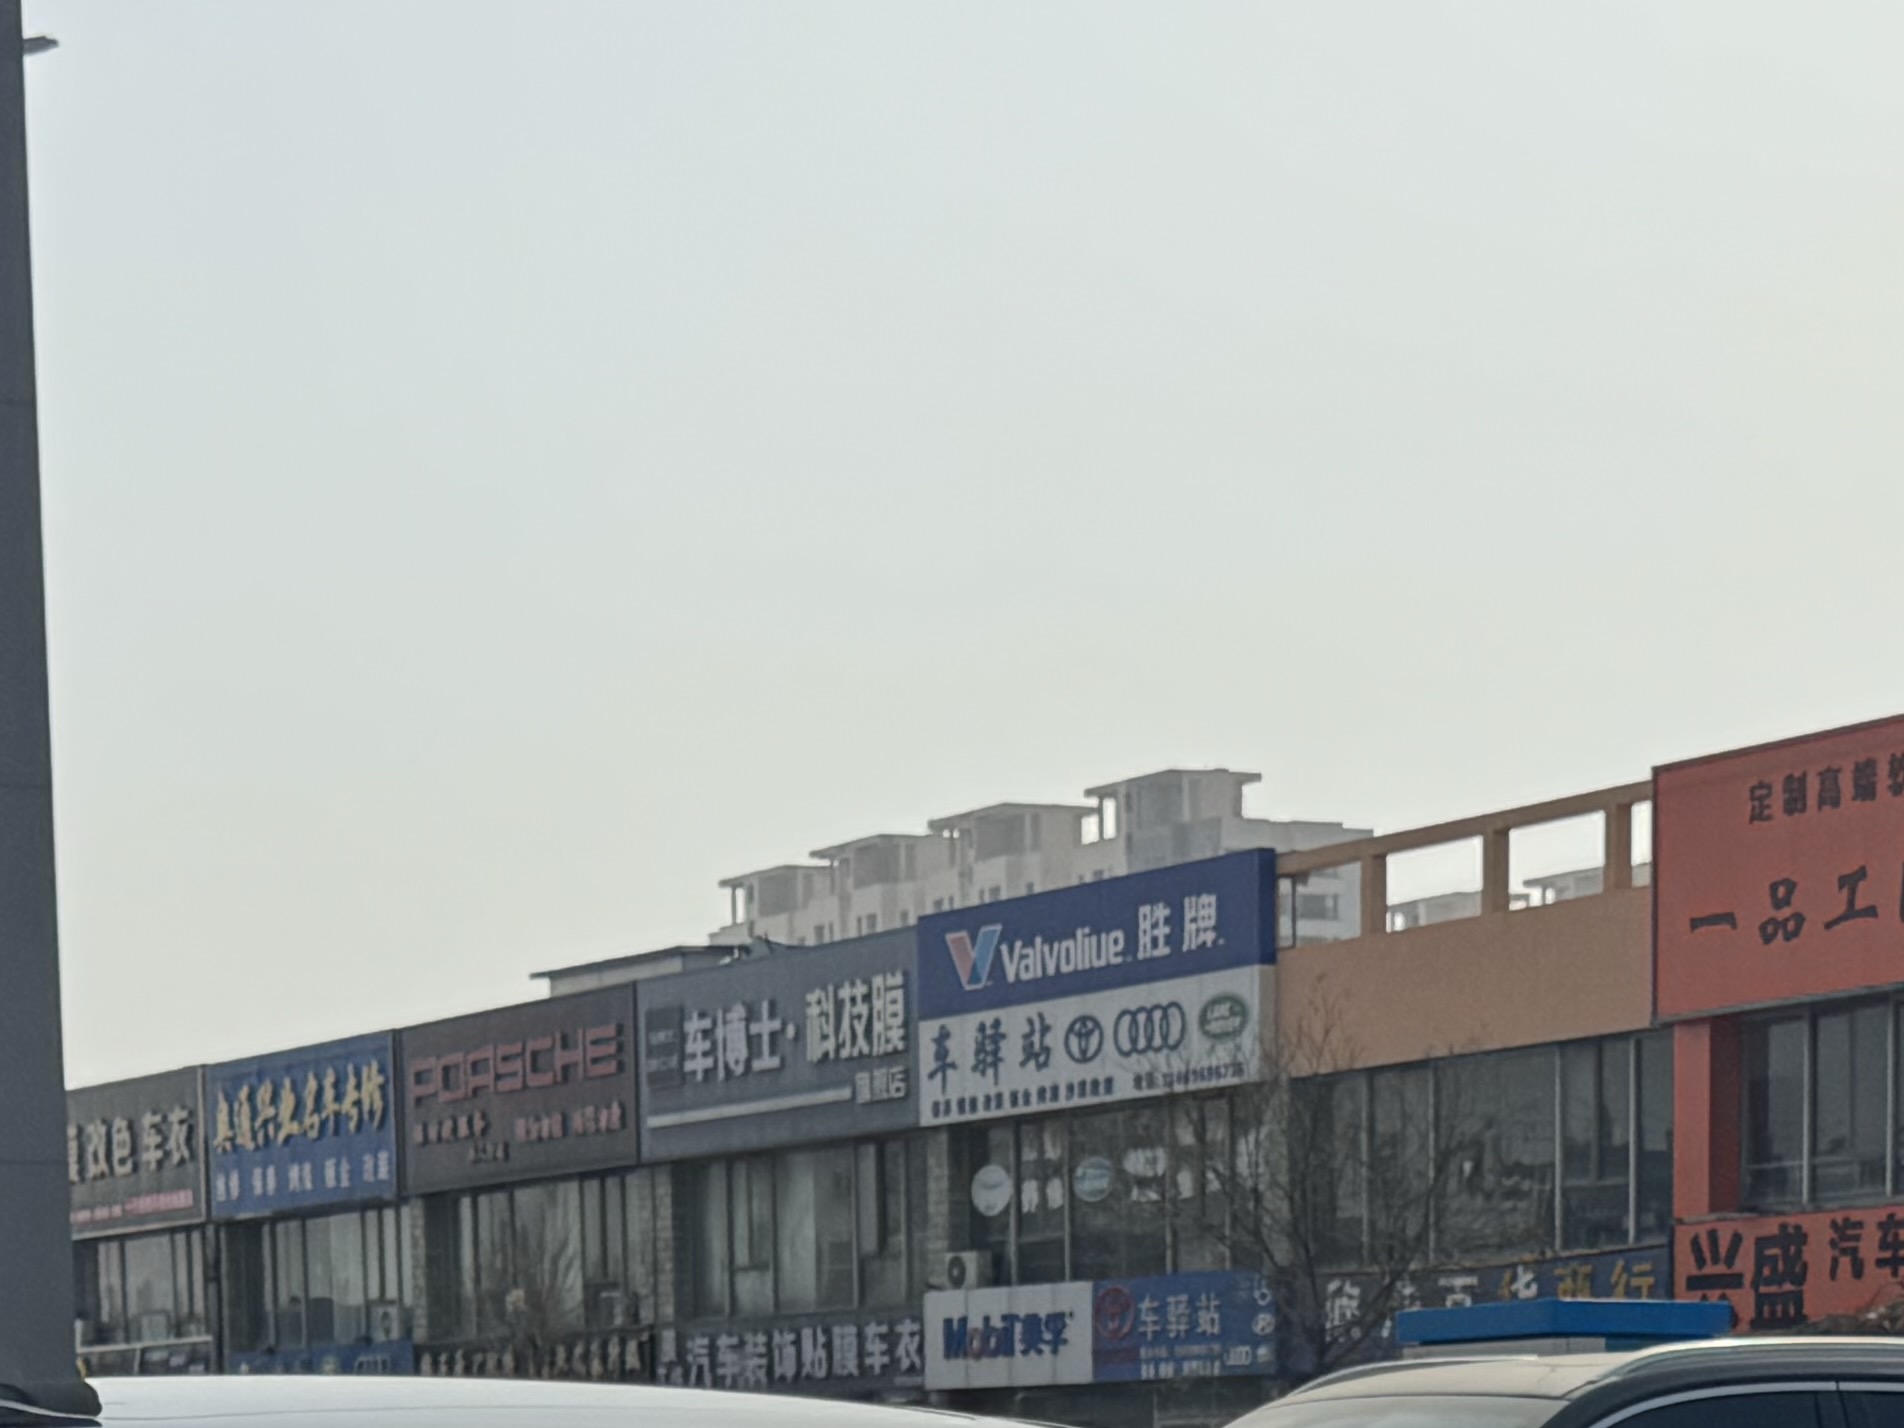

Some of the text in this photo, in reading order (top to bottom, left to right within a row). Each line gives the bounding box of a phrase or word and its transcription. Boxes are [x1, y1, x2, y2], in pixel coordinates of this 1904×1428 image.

[1137, 893, 1218, 960] 胜牌
[412, 1023, 617, 1107] PORSCHE
[1685, 1220, 1810, 1331] 兴盛
